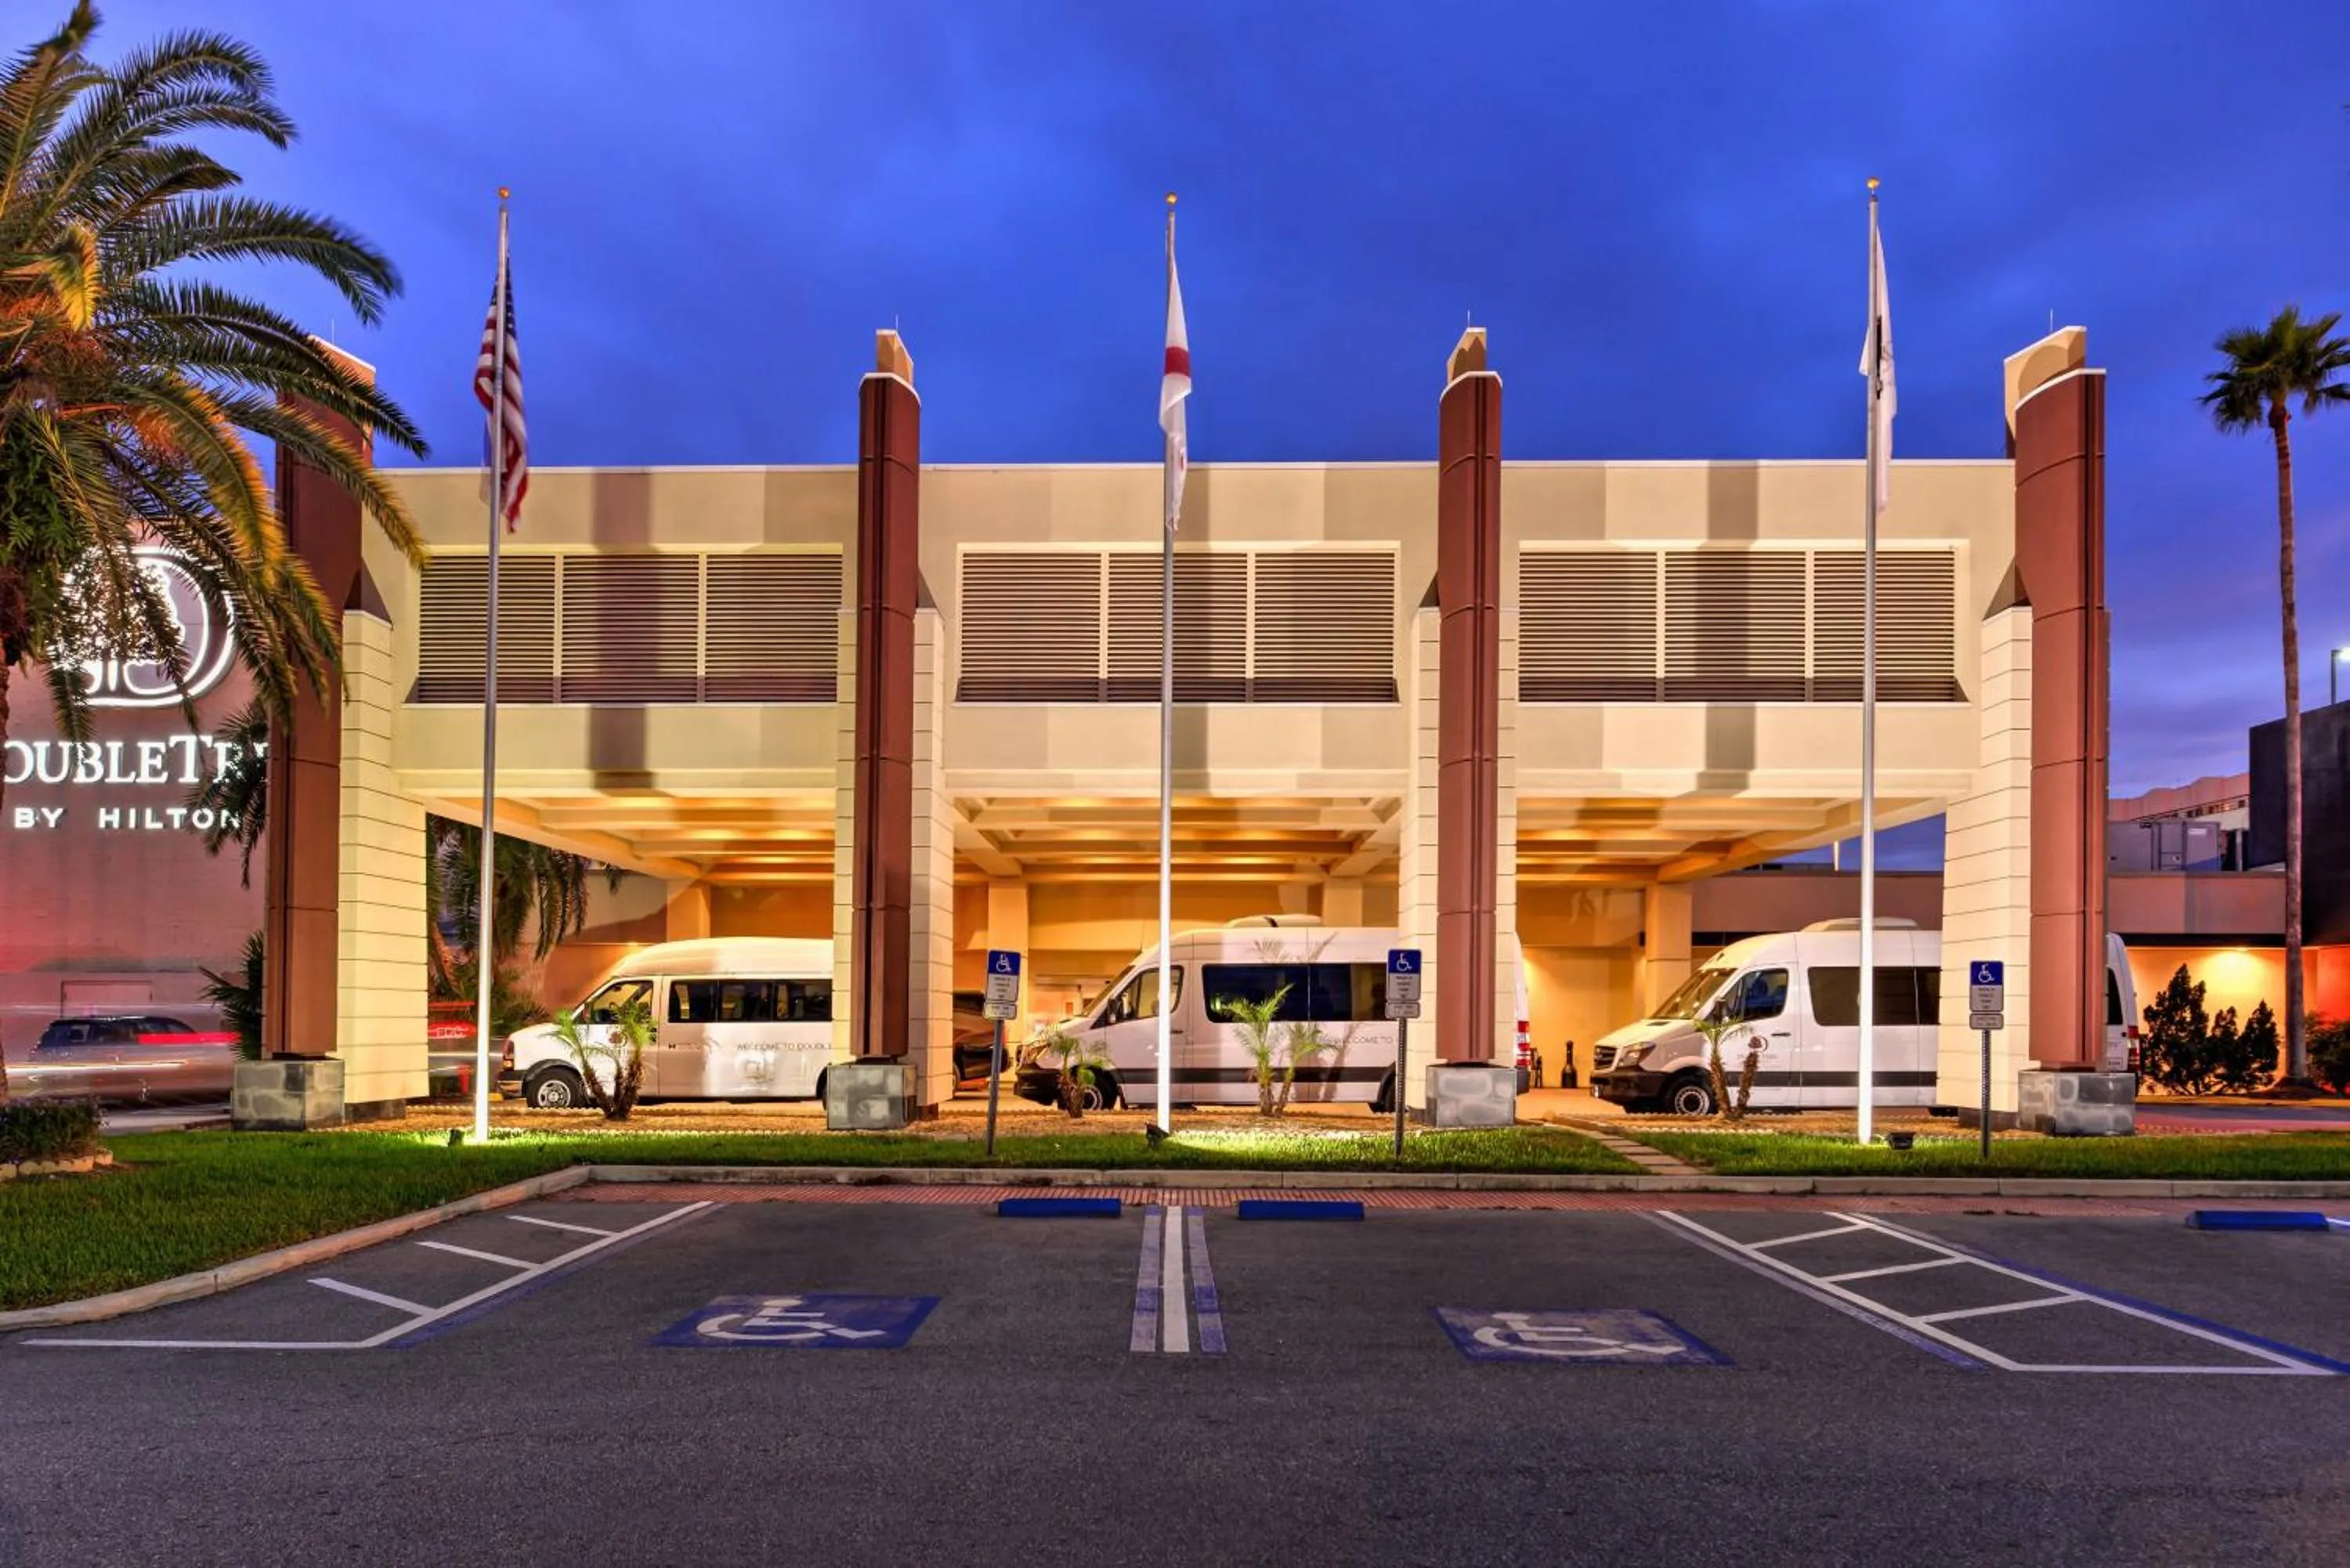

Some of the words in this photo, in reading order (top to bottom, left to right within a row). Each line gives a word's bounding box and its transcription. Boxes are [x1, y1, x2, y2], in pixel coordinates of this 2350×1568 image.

[3, 734, 268, 783] OUBLETR
[14, 807, 64, 828] BY
[99, 807, 240, 829] HILTON
